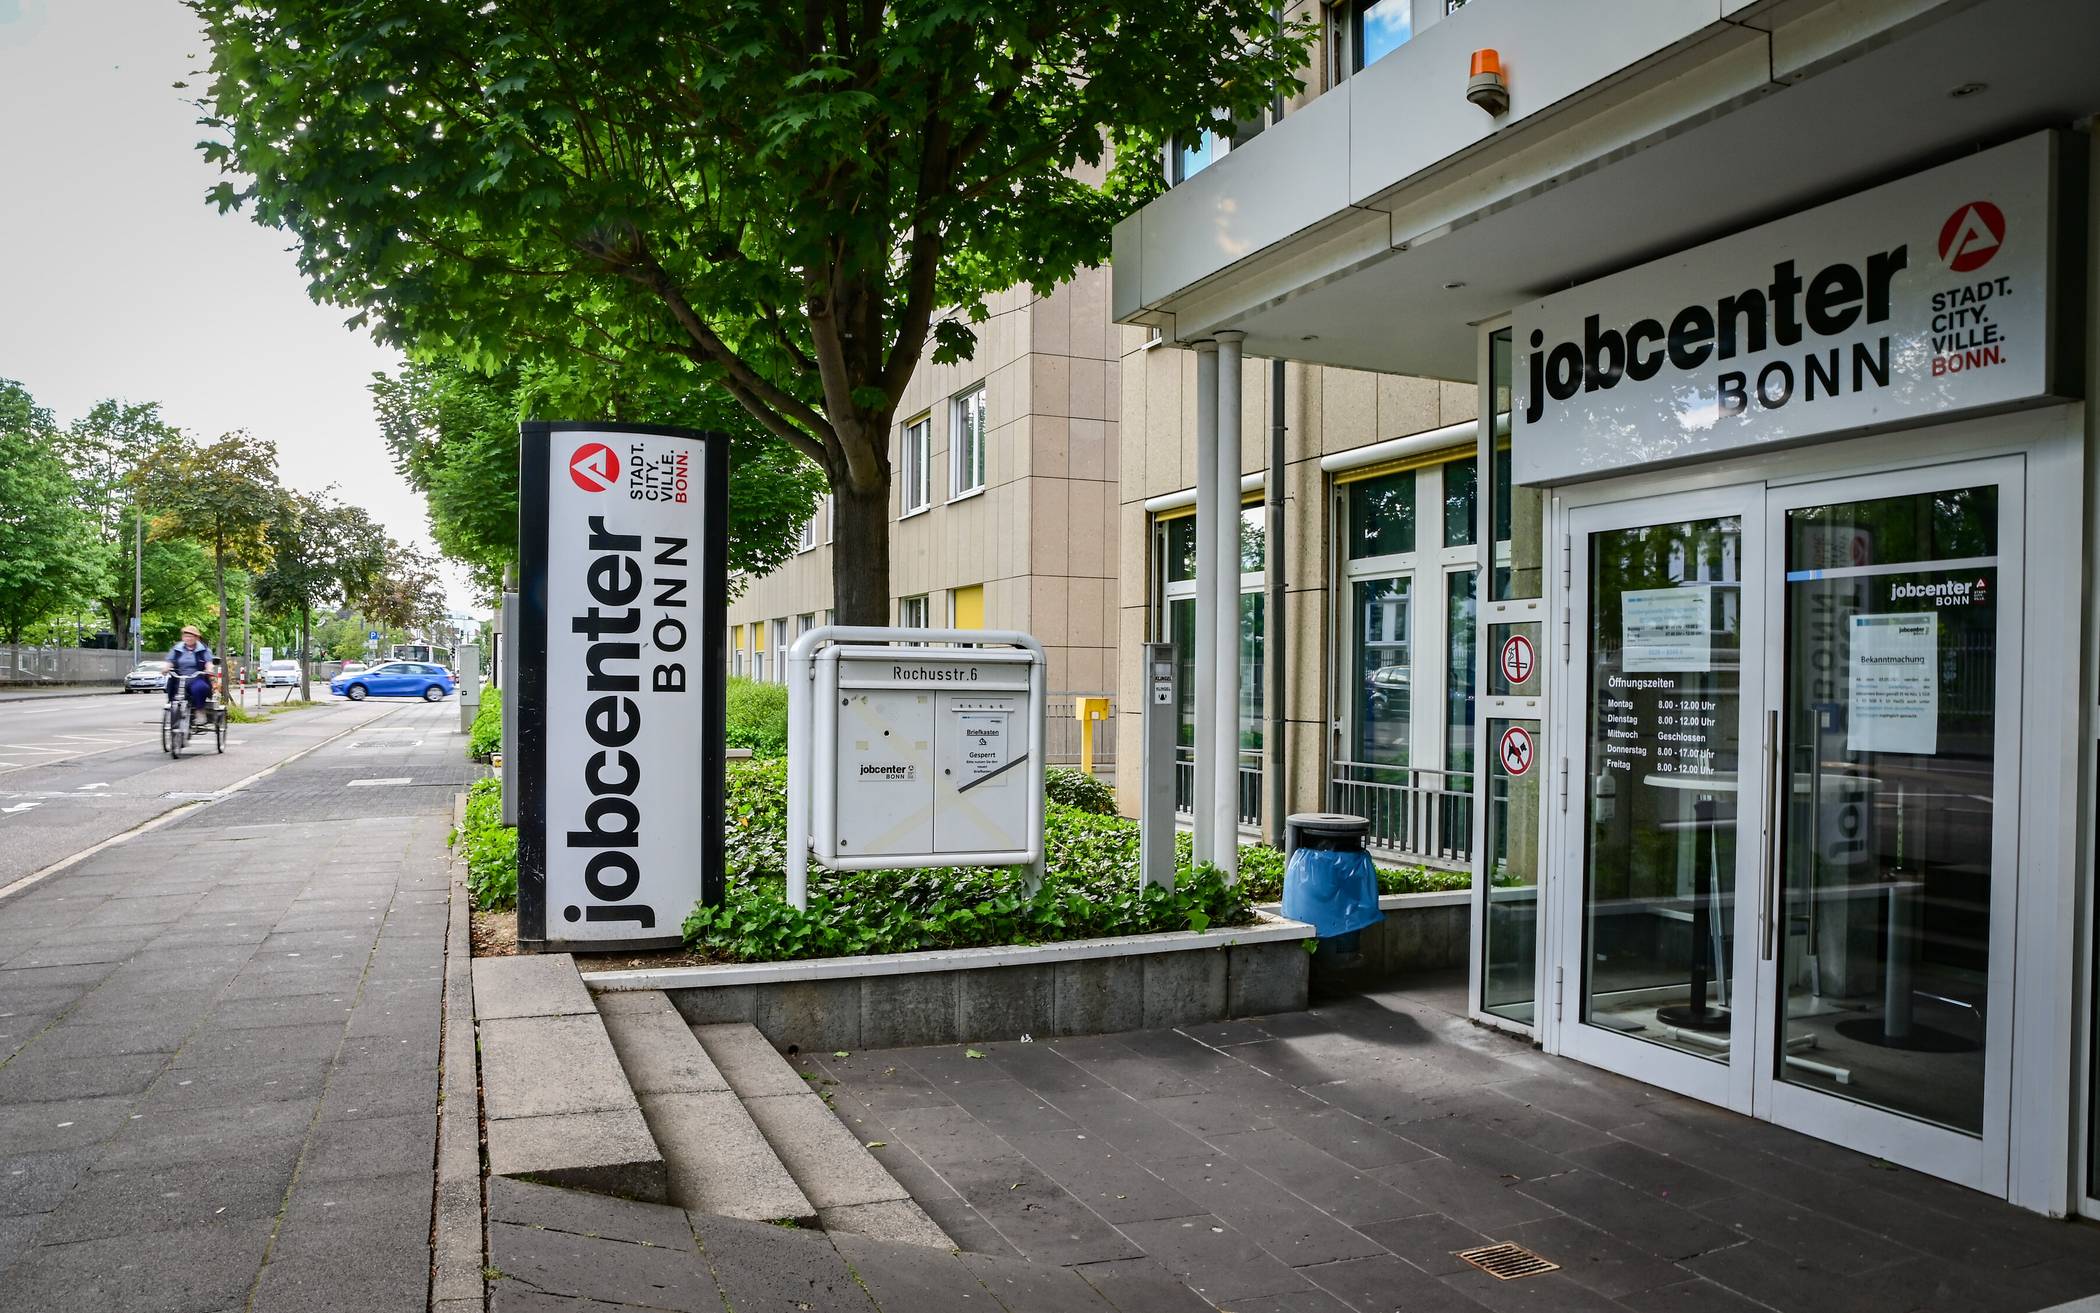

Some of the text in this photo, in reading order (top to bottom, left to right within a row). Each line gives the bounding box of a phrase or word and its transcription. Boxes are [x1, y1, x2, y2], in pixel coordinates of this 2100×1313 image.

[1932, 276, 2012, 312] STADT.
[1932, 303, 1989, 333] CITY.
[1527, 244, 1908, 424] jobcenter
[1932, 323, 2005, 354] VILLE.
[1932, 344, 2006, 377] BONN.
[1718, 336, 1890, 418] BONN
[630, 443, 644, 500] STADT.
[646, 460, 659, 501] CITY.
[661, 450, 674, 502] VILLE.
[676, 450, 688, 503] BONN.
[1891, 580, 1972, 601] jobcenter
[1936, 596, 1970, 606] BONN
[652, 536, 688, 692] BONN
[1860, 655, 1925, 664] Bekanntmachung
[1608, 675, 1674, 689] Öffnungszeiten
[1607, 699, 1633, 710] Montag
[1658, 700, 1673, 709] 8.00
[1680, 701, 1699, 710] 12.00
[1701, 701, 1716, 710] Uhr
[564, 515, 656, 929] jobcenter
[1607, 714, 1638, 725] Dienstag
[1658, 716, 1673, 725] 8.00
[1680, 717, 1699, 726] 12.00
[1701, 717, 1716, 726] Uhr
[1607, 729, 1706, 742] Mittwoch Geschlossen
[1607, 744, 1647, 756] Donnerstag
[1657, 747, 1672, 756] 8.00
[1679, 749, 1699, 758] 17.00
[1700, 749, 1715, 759] Uhr
[860, 764, 906, 776] jobcenter
[1606, 759, 1631, 770] Freitag
[1657, 763, 1672, 772] 8.00
[1679, 764, 1698, 774] 12.00
[1700, 766, 1714, 775] Uhr
